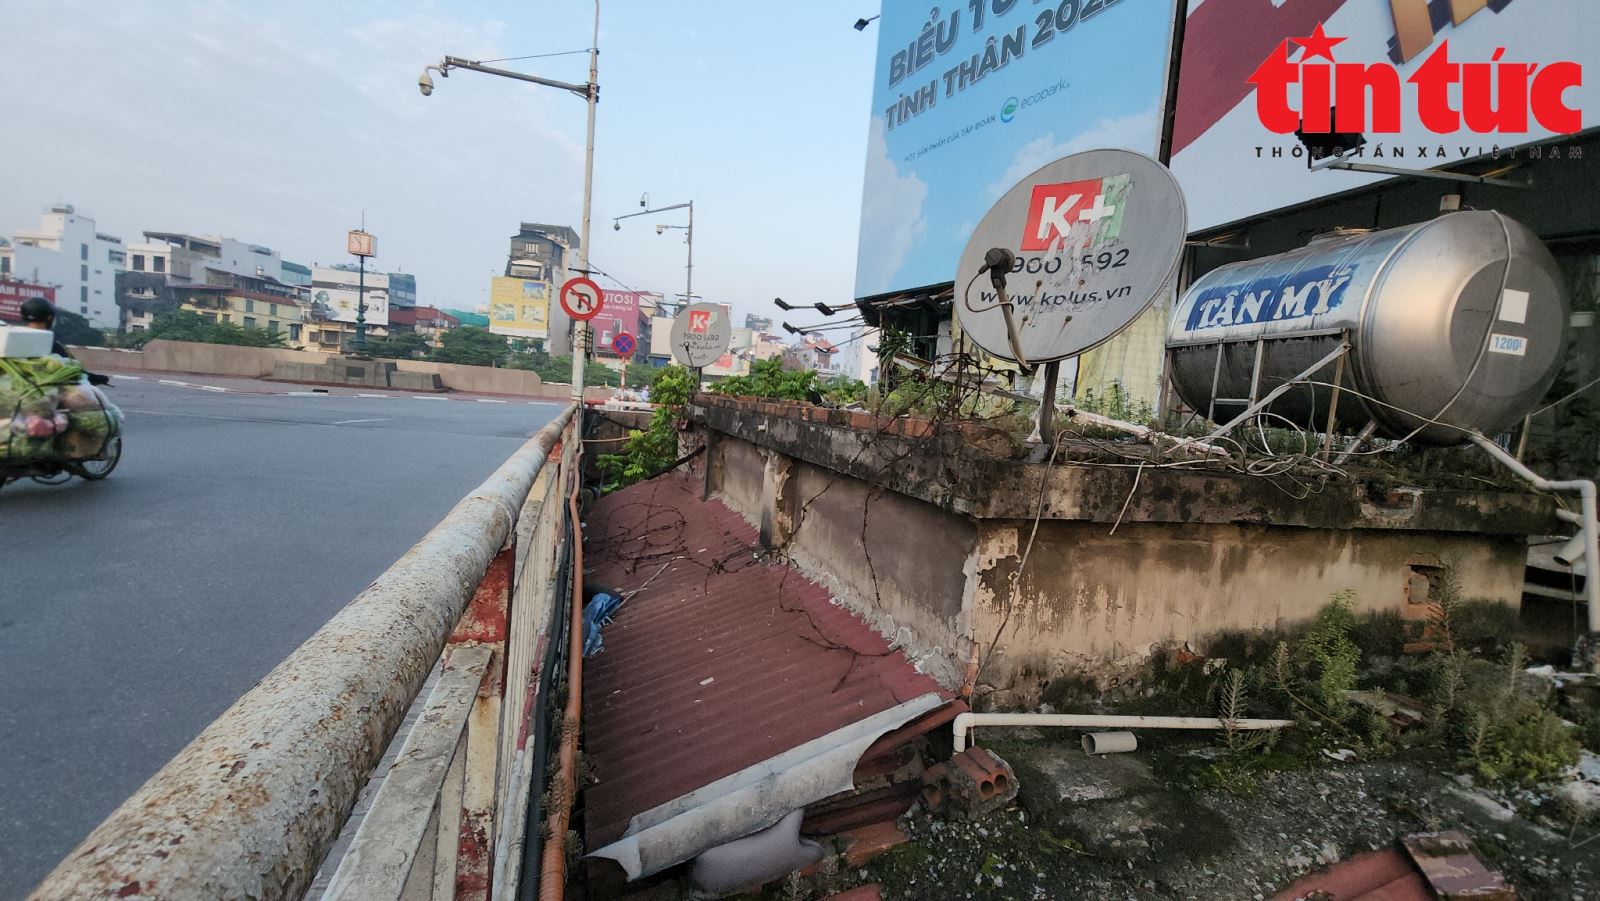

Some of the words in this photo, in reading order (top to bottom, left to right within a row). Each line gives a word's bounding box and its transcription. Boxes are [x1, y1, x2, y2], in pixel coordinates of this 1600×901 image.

[888, 6, 960, 89] BIỂU
[1031, 0, 1123, 48] 202
[1011, 255, 1062, 275] 900
[979, 284, 1133, 307] wwkplus.vn
[1197, 289, 1272, 328] TÂN
[1272, 267, 1352, 321] MỸ
